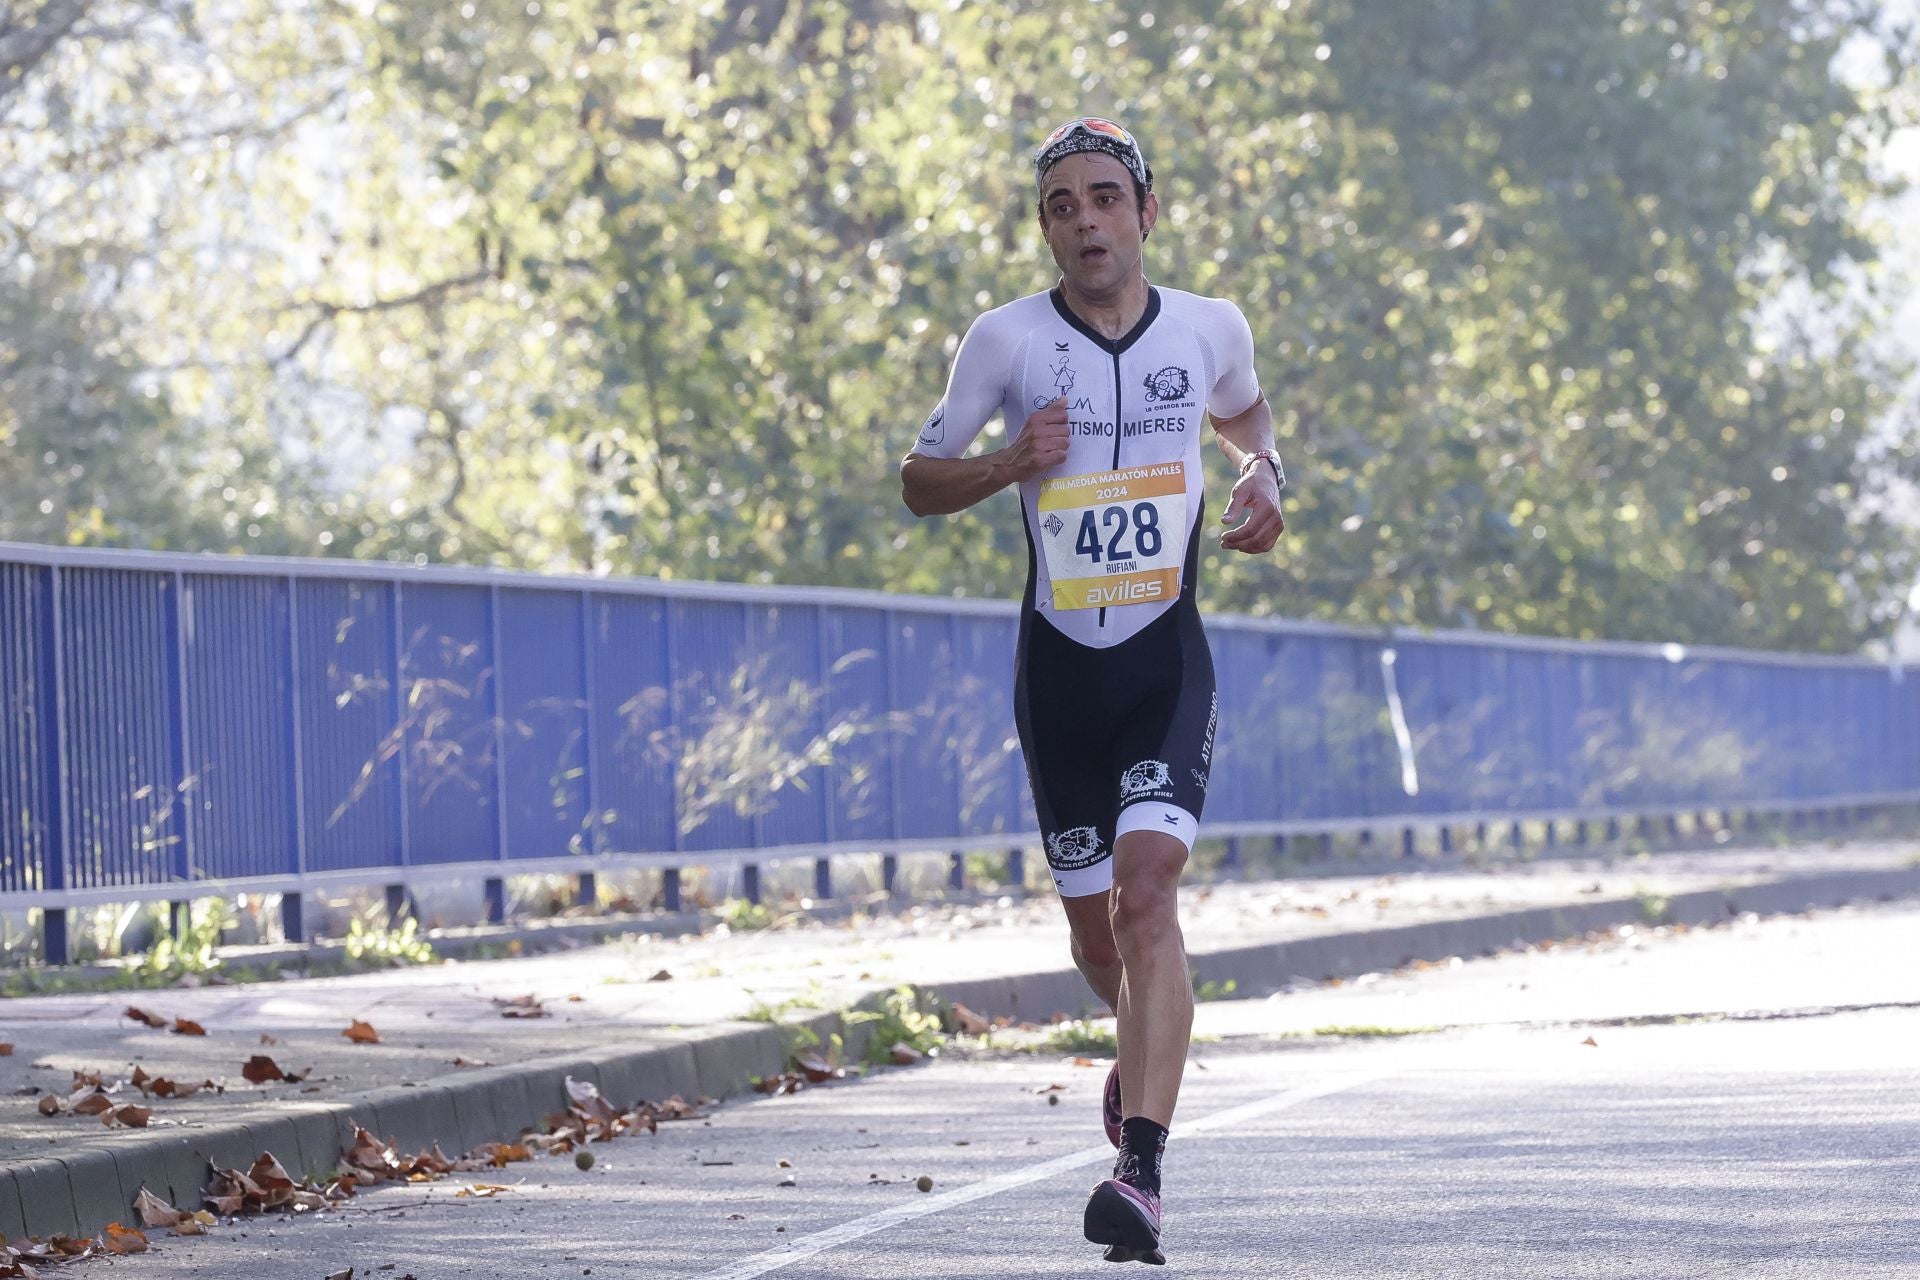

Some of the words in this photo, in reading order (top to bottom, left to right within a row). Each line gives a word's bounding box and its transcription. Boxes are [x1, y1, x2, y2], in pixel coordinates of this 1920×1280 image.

[1069, 421, 1114, 437] TISMO
[1123, 417, 1186, 437] MIERES
[1067, 476, 1098, 489] MEDIA
[1100, 468, 1149, 484] MARATÓN
[1150, 463, 1181, 477] AVILÉS
[1095, 485, 1128, 500] 2024
[1075, 501, 1162, 563] 428
[1106, 561, 1138, 574] RUFIANI
[1086, 579, 1163, 604] avilés
